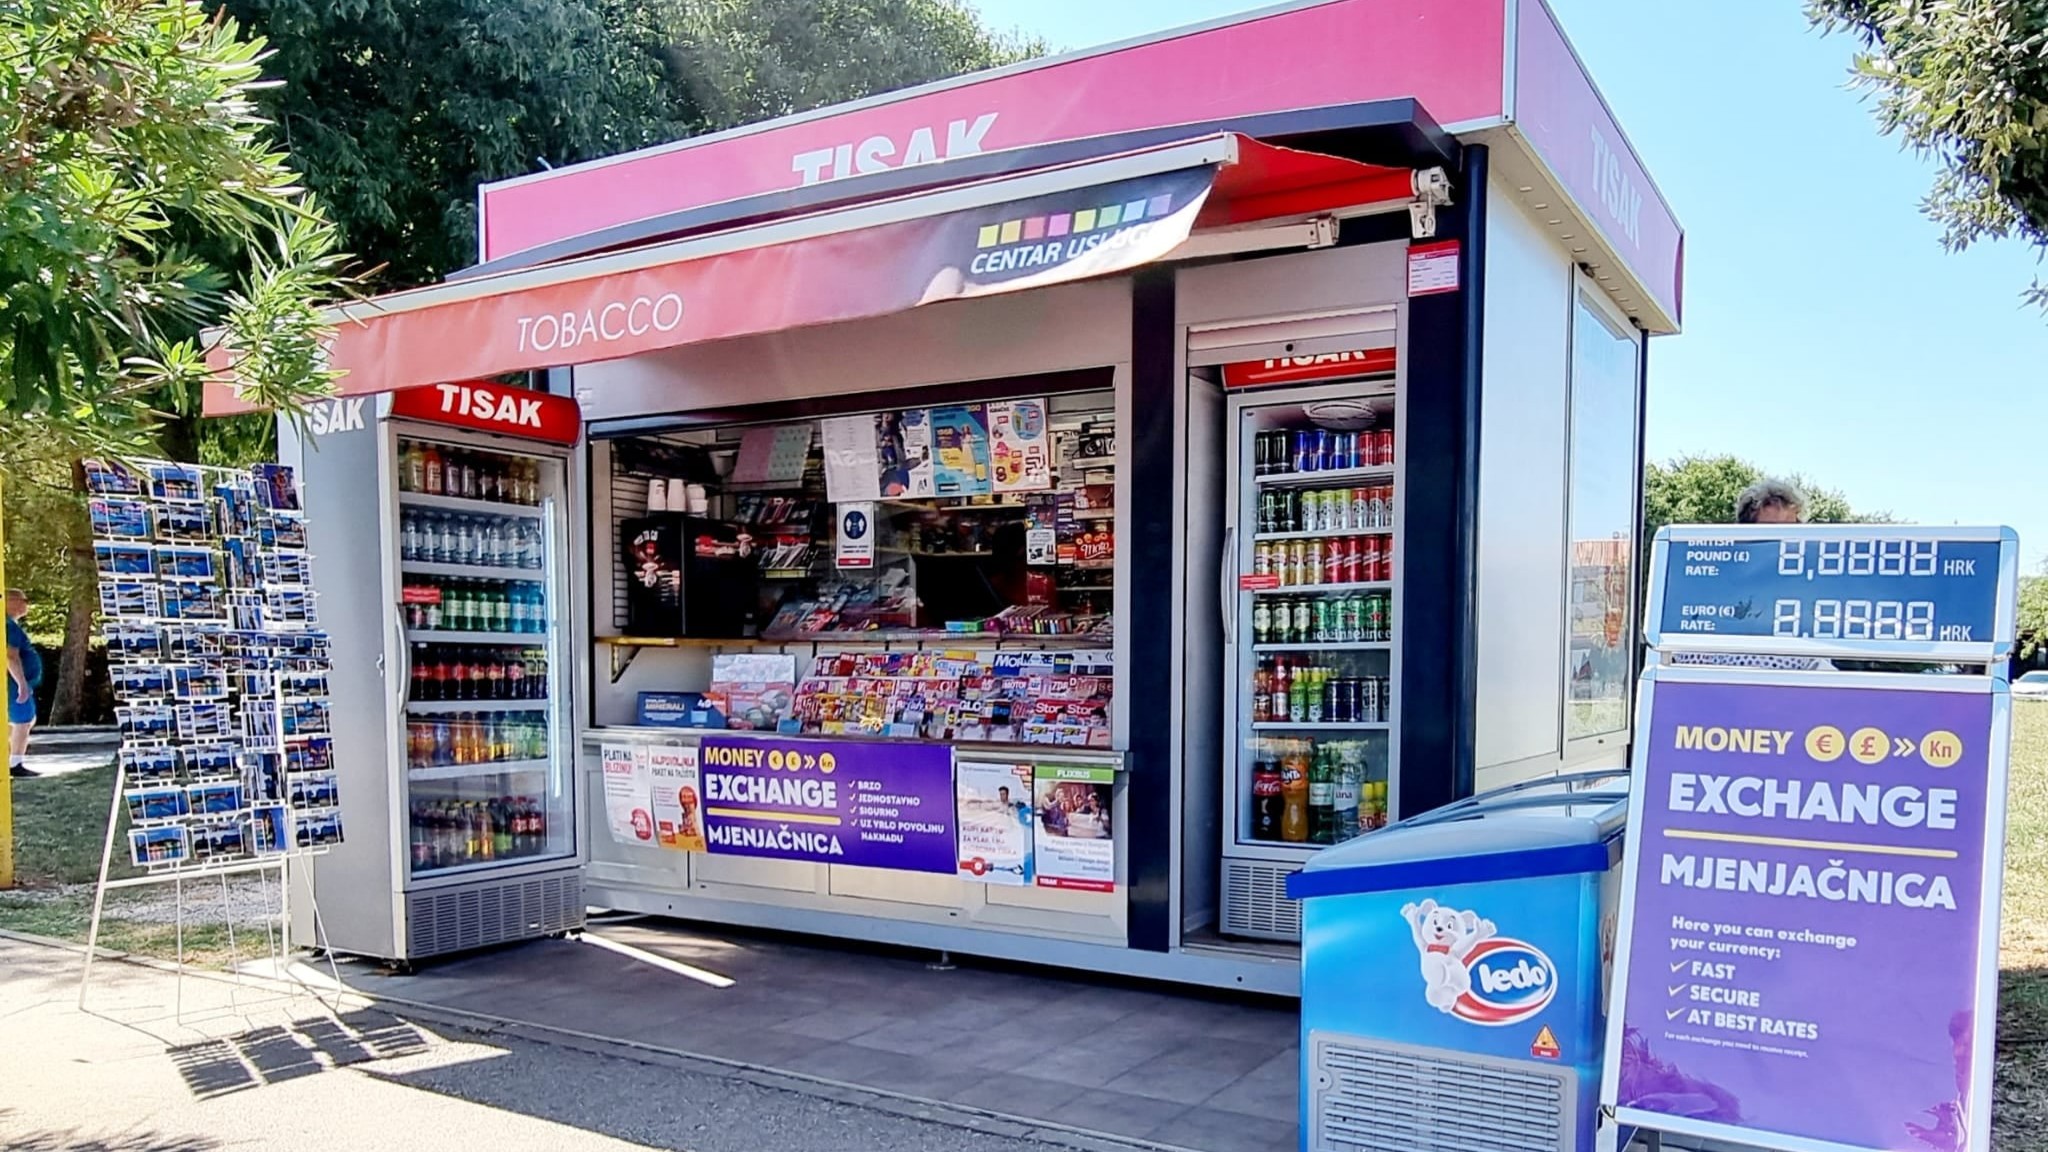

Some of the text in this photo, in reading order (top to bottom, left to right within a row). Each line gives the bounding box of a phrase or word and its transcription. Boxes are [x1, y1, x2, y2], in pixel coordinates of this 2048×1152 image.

[792, 112, 999, 187] TISAK
[1591, 123, 1643, 250] TISAK
[969, 239, 1063, 275] CENTAR
[517, 293, 684, 353] TOBACCO
[436, 382, 544, 428] TISAK
[1687, 551, 1750, 562] POUND (£)
[1944, 560, 1976, 576] HRK
[1685, 566, 1719, 576] RATE:
[1682, 605, 1716, 616] EURO
[1681, 620, 1716, 631] RATE:
[1940, 625, 1972, 641] HRK
[1675, 725, 1794, 755] MONEY
[705, 746, 765, 769] MONEY
[705, 773, 837, 808] EXCHANGE
[857, 780, 882, 791] BRZO
[858, 793, 921, 806] JEDNOSTAVNO
[1668, 772, 1958, 830] EXCHANGE
[859, 806, 899, 818] SIGURNO
[860, 819, 945, 834] UZ VRLO POVOLJNU
[861, 832, 904, 844] NAKNADU
[707, 824, 844, 855] MJENJAČNICA
[1660, 853, 1958, 910] MJENJAČNICA
[1672, 916, 1857, 949] Here you can exchange
[1670, 936, 1781, 960] your currency:
[1691, 961, 1736, 980] FAST
[1690, 984, 1760, 1007] SECURE
[1687, 1009, 1819, 1040] AT BEST RATES
